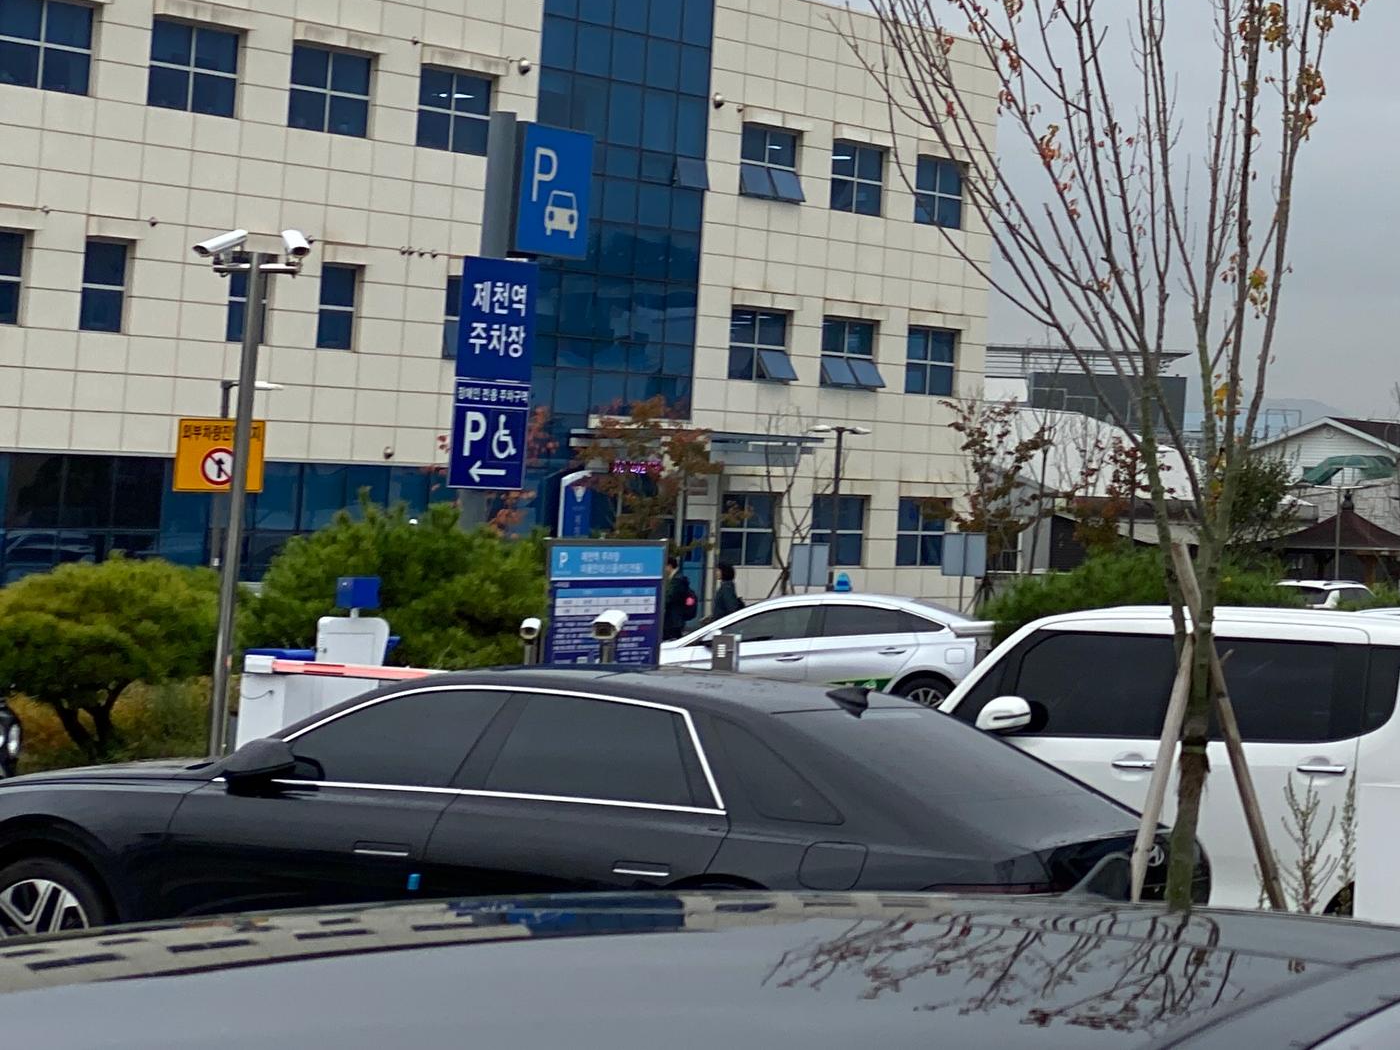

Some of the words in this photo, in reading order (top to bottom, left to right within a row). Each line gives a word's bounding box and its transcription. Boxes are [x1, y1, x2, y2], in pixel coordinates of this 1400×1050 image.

[531, 146, 559, 202] P
[471, 281, 528, 317] 제천역
[468, 322, 527, 358] 주차장
[182, 424, 262, 442] 외부차량진지
[462, 411, 487, 458] P
